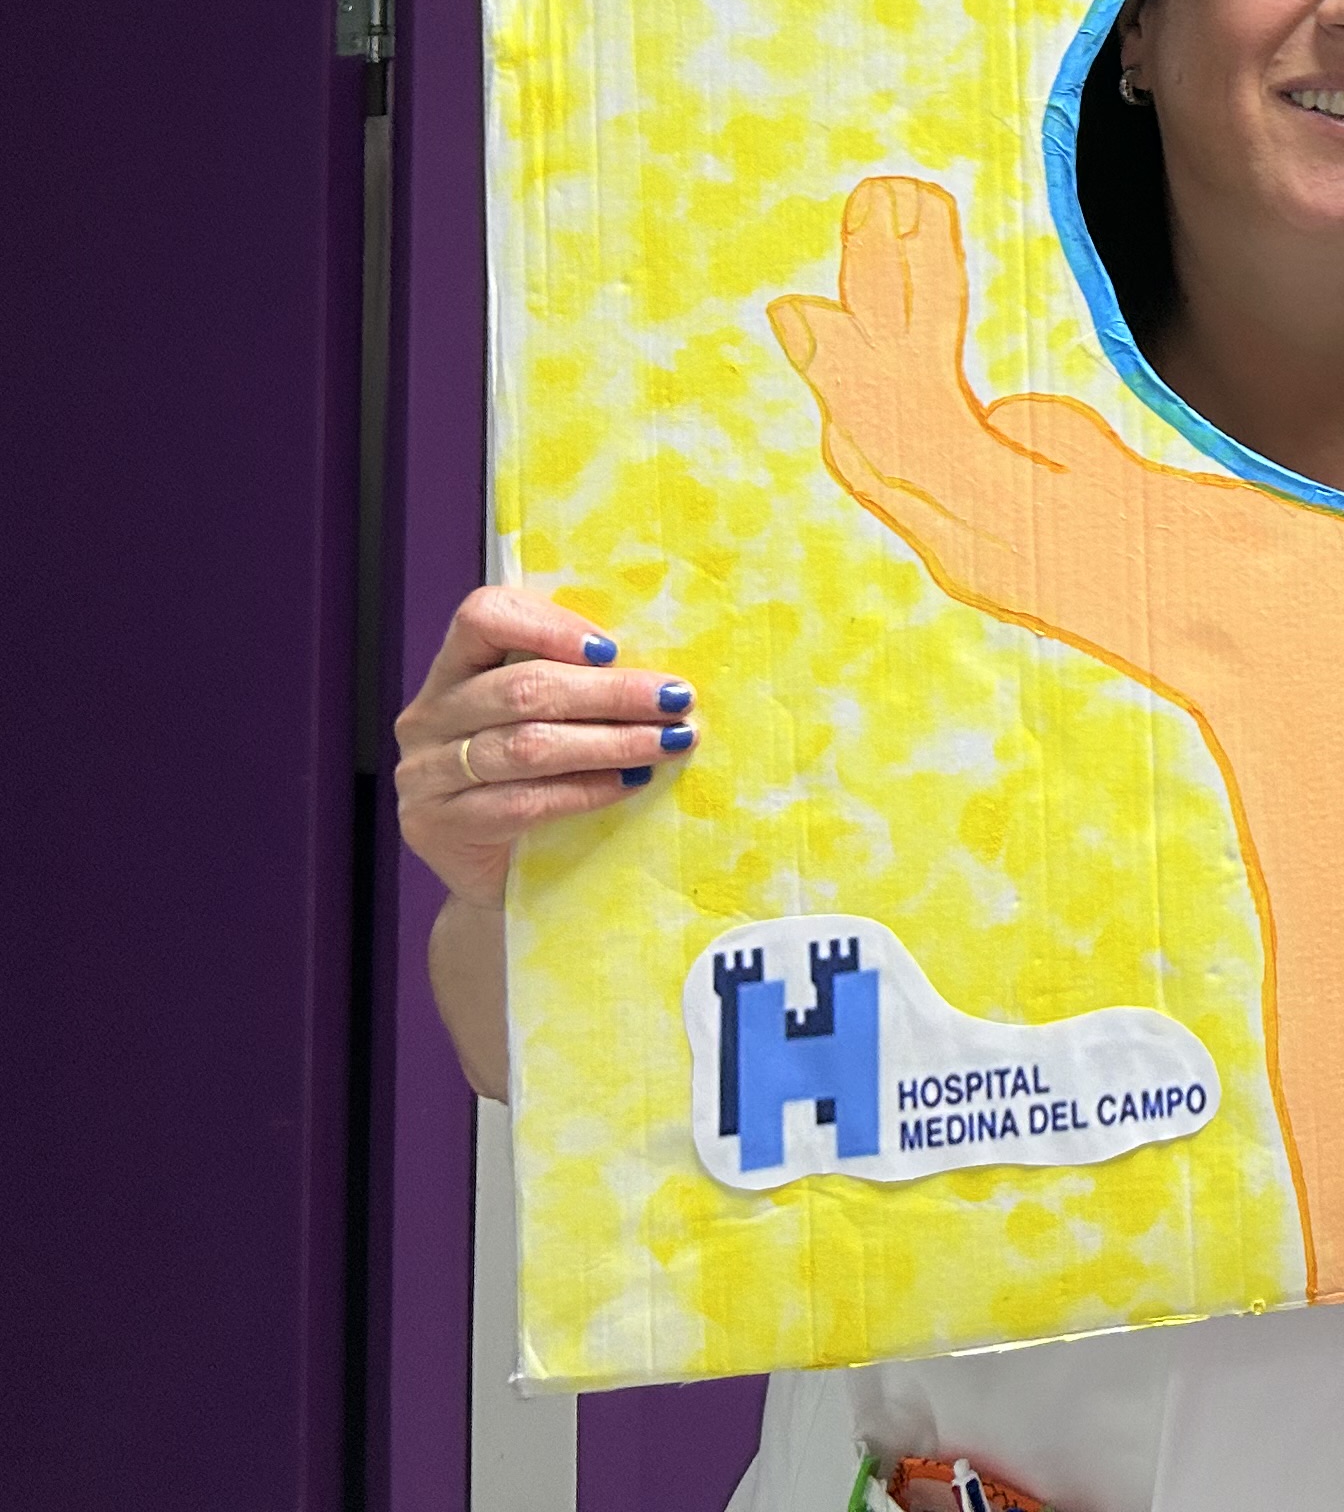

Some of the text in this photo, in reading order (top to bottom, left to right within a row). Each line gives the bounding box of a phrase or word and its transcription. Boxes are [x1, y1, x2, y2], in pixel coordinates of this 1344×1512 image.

[897, 1064, 1051, 1112] HOSPITAL
[898, 1082, 1208, 1152] MEDINA DEL CAMPO
